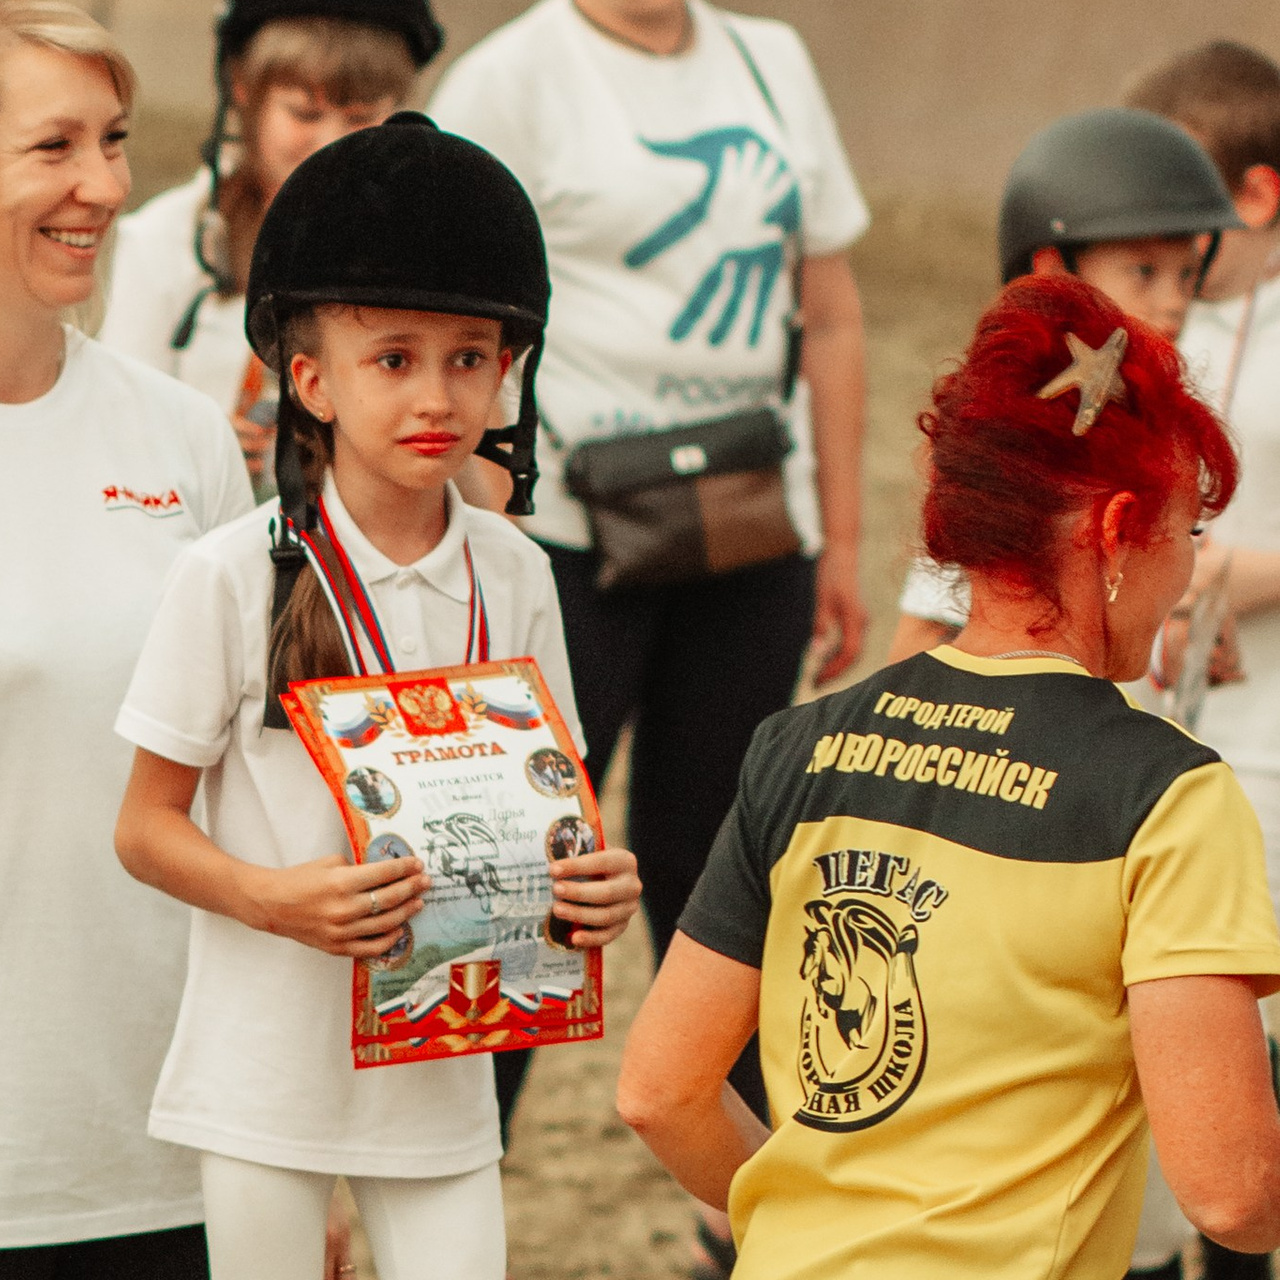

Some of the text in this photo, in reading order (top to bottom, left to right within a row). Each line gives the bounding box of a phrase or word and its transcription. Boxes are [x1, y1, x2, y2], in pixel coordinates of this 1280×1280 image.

[873, 691, 1016, 735] ГОРОД-ГЕРОЙ
[391, 741, 507, 766] ГРАМОТА
[417, 772, 505, 790] НАГРАЖДАЕТСЯ
[866, 997, 915, 1103] ШКОЛА
